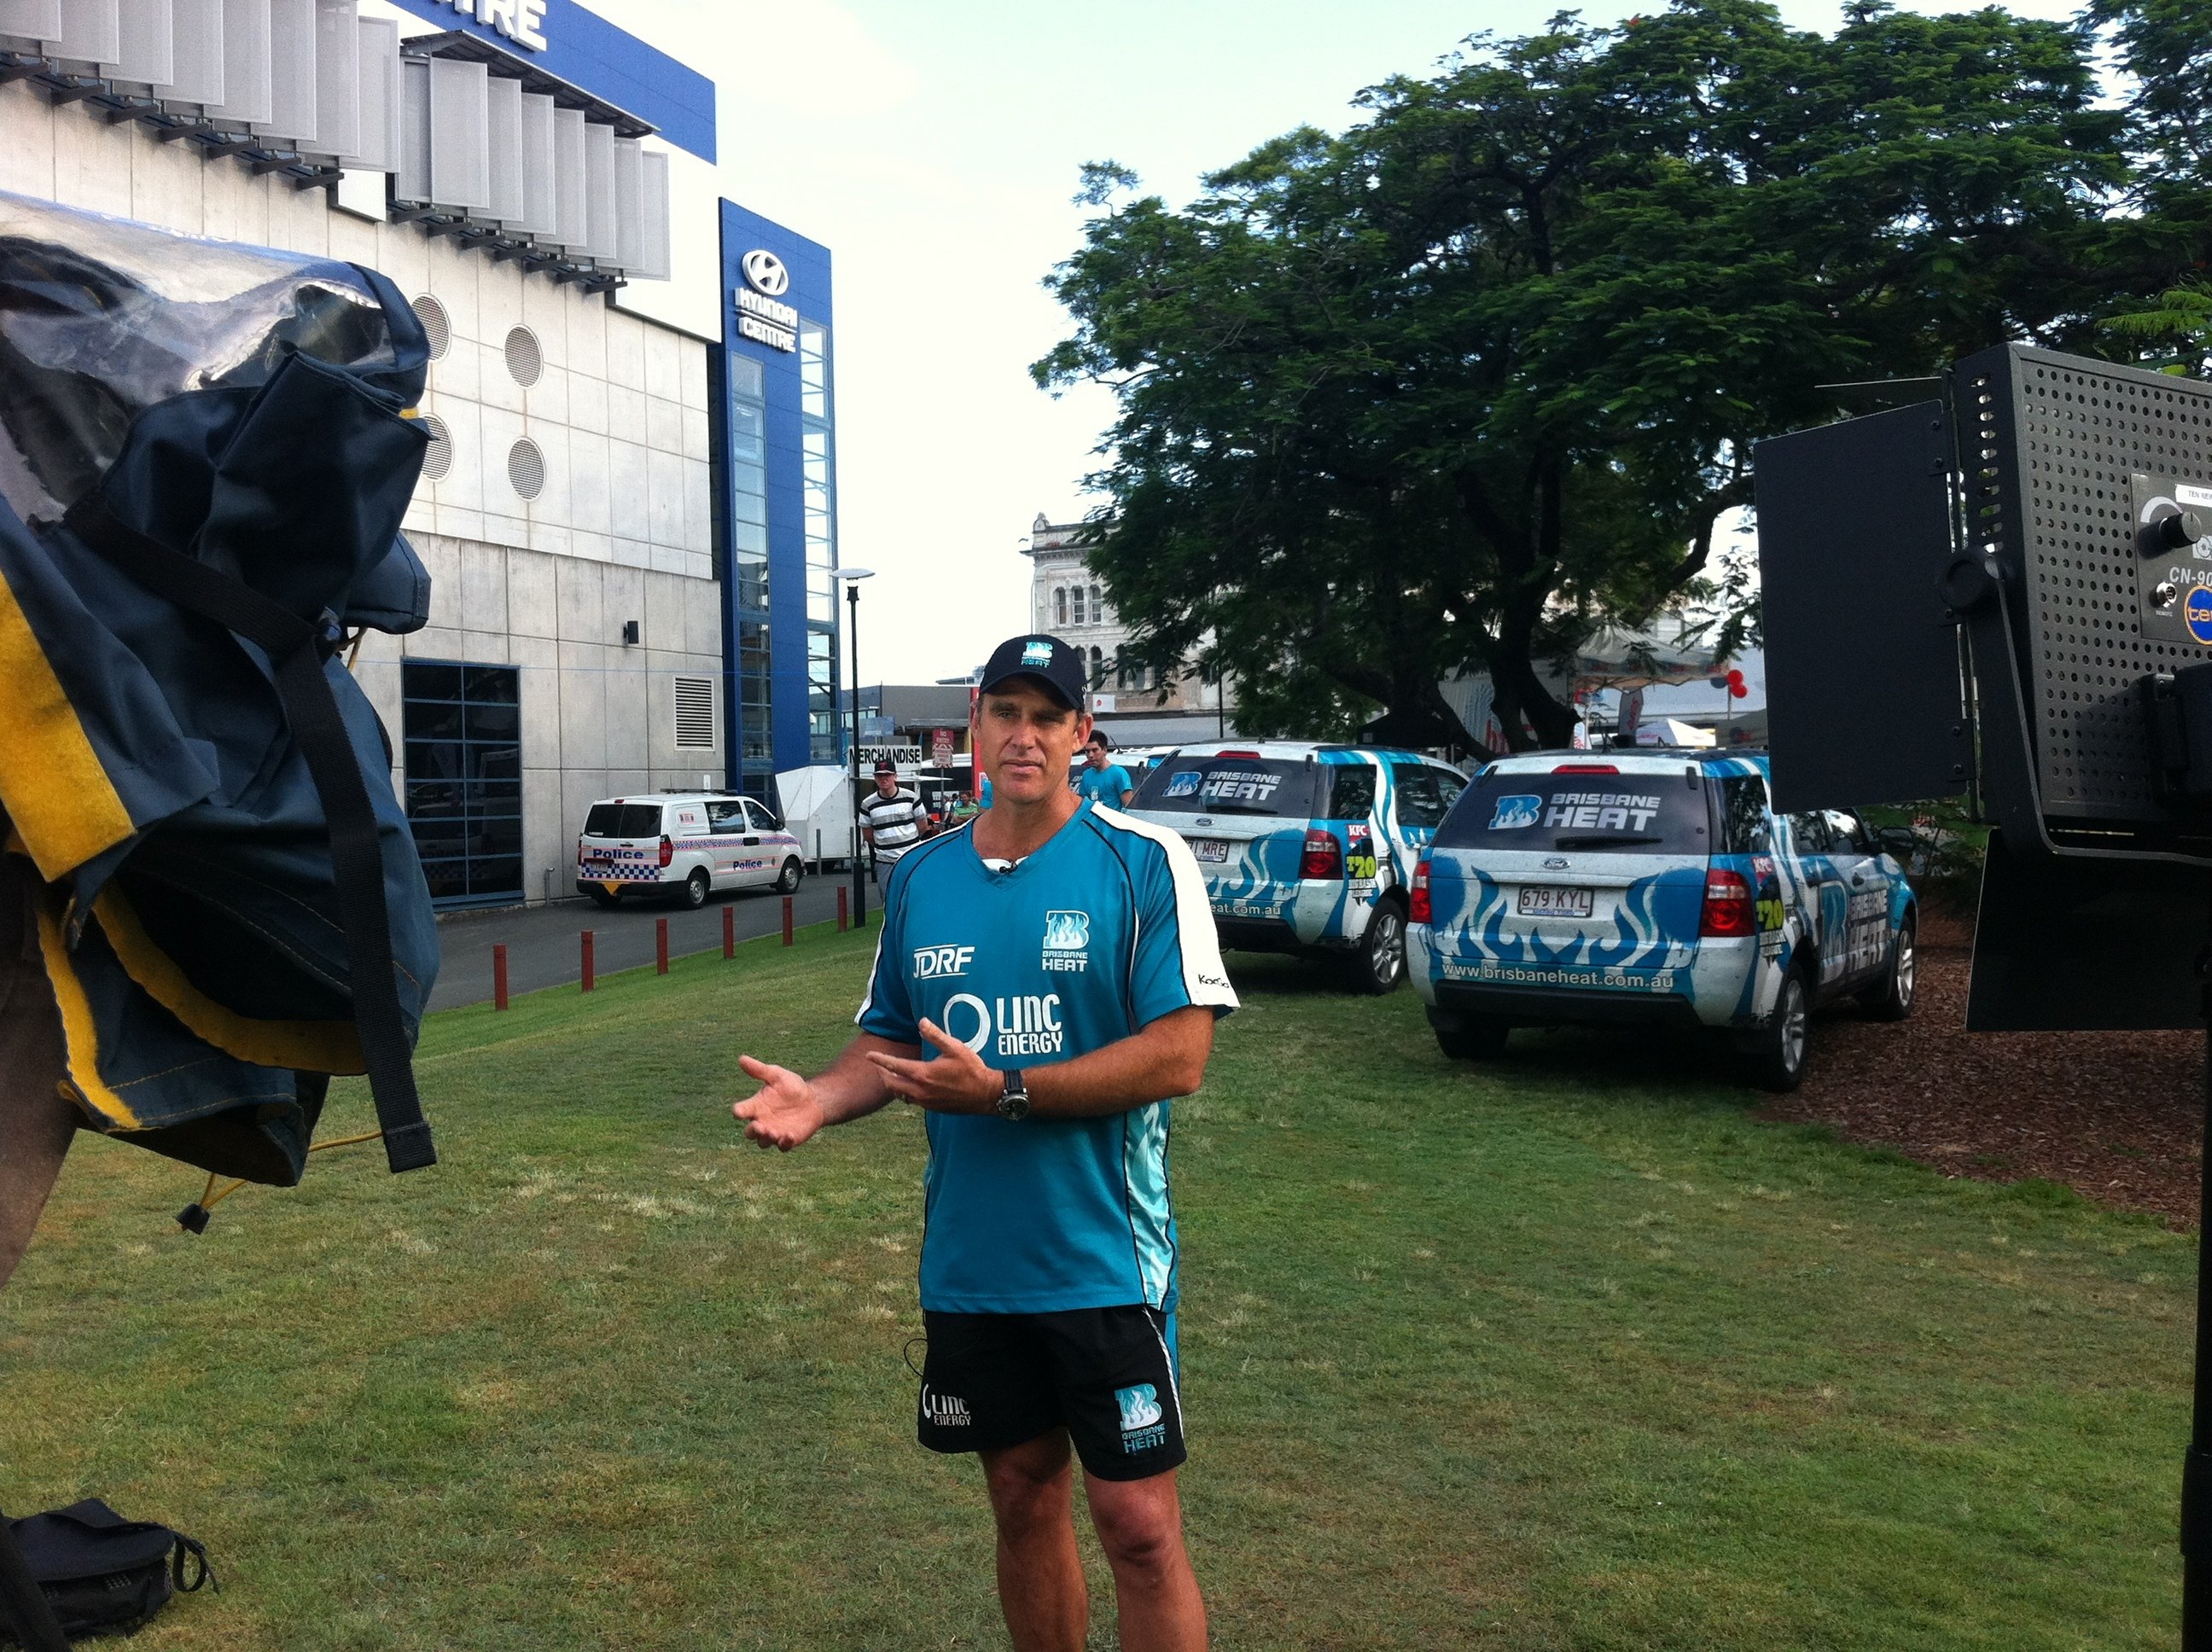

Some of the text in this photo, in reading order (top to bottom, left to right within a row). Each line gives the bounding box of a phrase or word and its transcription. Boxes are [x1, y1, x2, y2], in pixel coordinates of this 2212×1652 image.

[735, 287, 798, 328] HYUNDAI
[738, 317, 796, 353] CENTRE
[1207, 771, 1282, 784] BRISBANE
[1198, 781, 1277, 800] HEAT
[1551, 793, 1661, 808] BRISBANE
[1543, 806, 1656, 832] HEAT
[1348, 824, 1367, 836] KFC
[593, 849, 644, 859] Police
[1202, 841, 1226, 856] MRE
[733, 860, 762, 870] Police
[1346, 856, 1376, 878] T20
[1522, 890, 1588, 909] 679 KYL
[913, 945, 975, 979] JDRF
[1042, 958, 1087, 972] HEAT
[1442, 963, 1674, 988] www.brisbaneheat.com.au
[996, 993, 1062, 1034] LINC
[998, 1031, 1062, 1056] ENERGY
[934, 1414, 971, 1426] ENERGY
[1121, 1423, 1166, 1440] BRISBANE
[1123, 1432, 1166, 1454] HEAT
